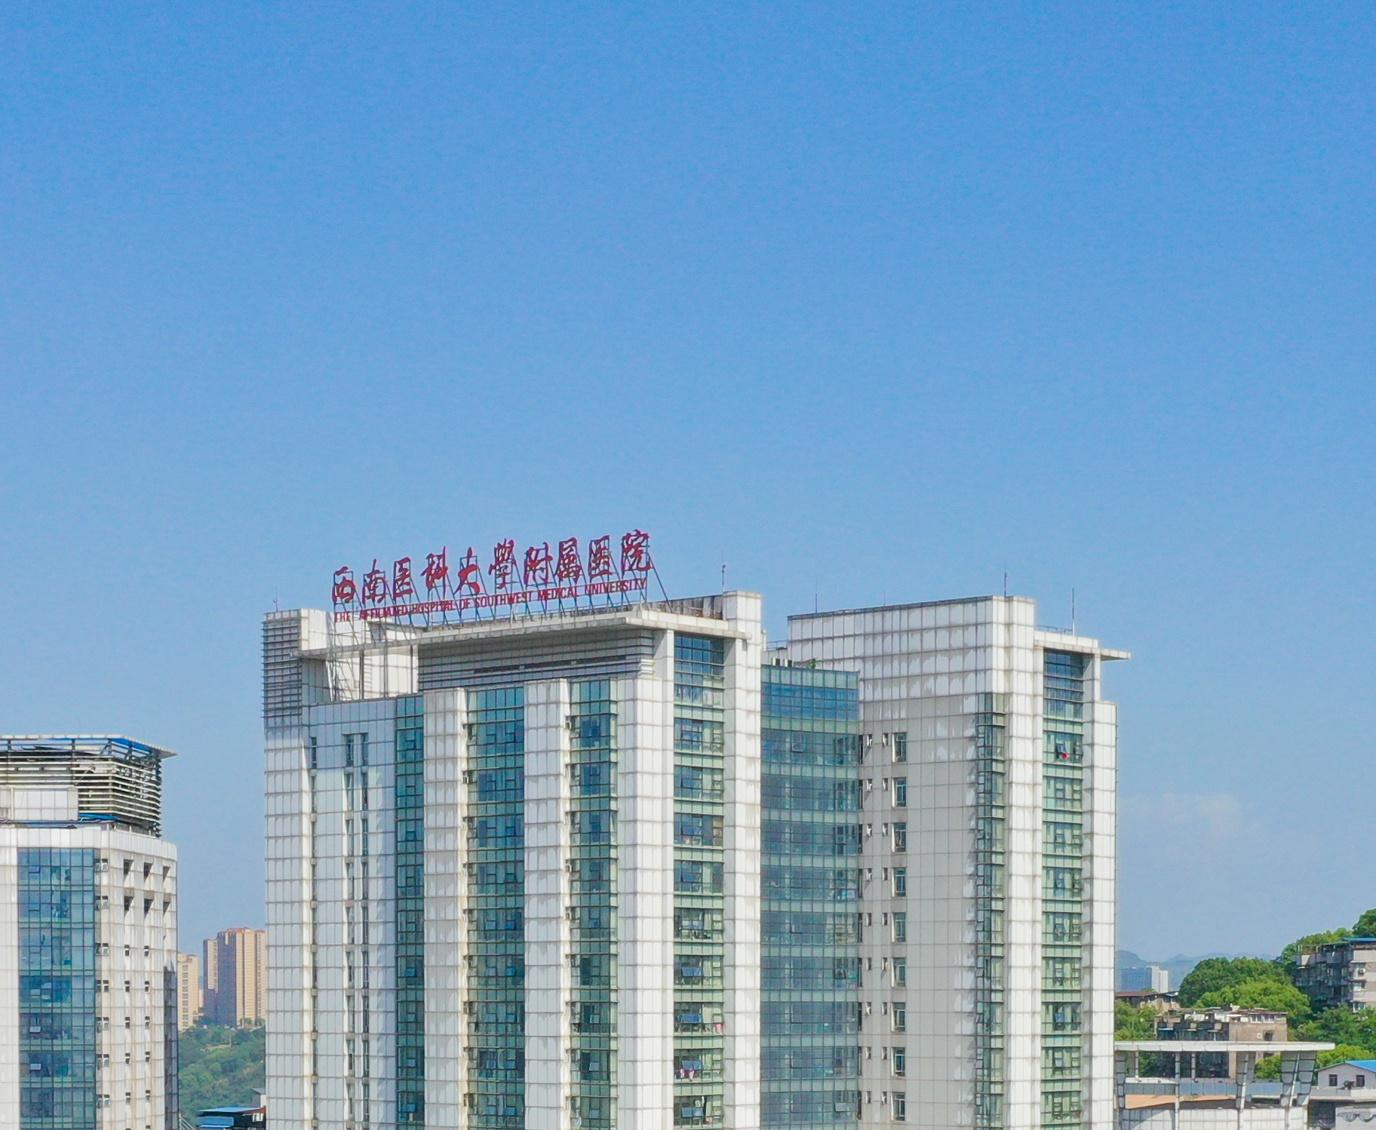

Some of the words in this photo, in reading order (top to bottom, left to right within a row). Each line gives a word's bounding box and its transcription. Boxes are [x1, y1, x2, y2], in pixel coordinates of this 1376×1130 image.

[335, 612, 351, 623] THE
[411, 600, 455, 615] HOSPITAL
[460, 599, 471, 610] OF
[475, 591, 532, 608] SOUTHWEST
[538, 586, 579, 600] MEDICAL
[585, 578, 647, 596] UNIVERSITY
